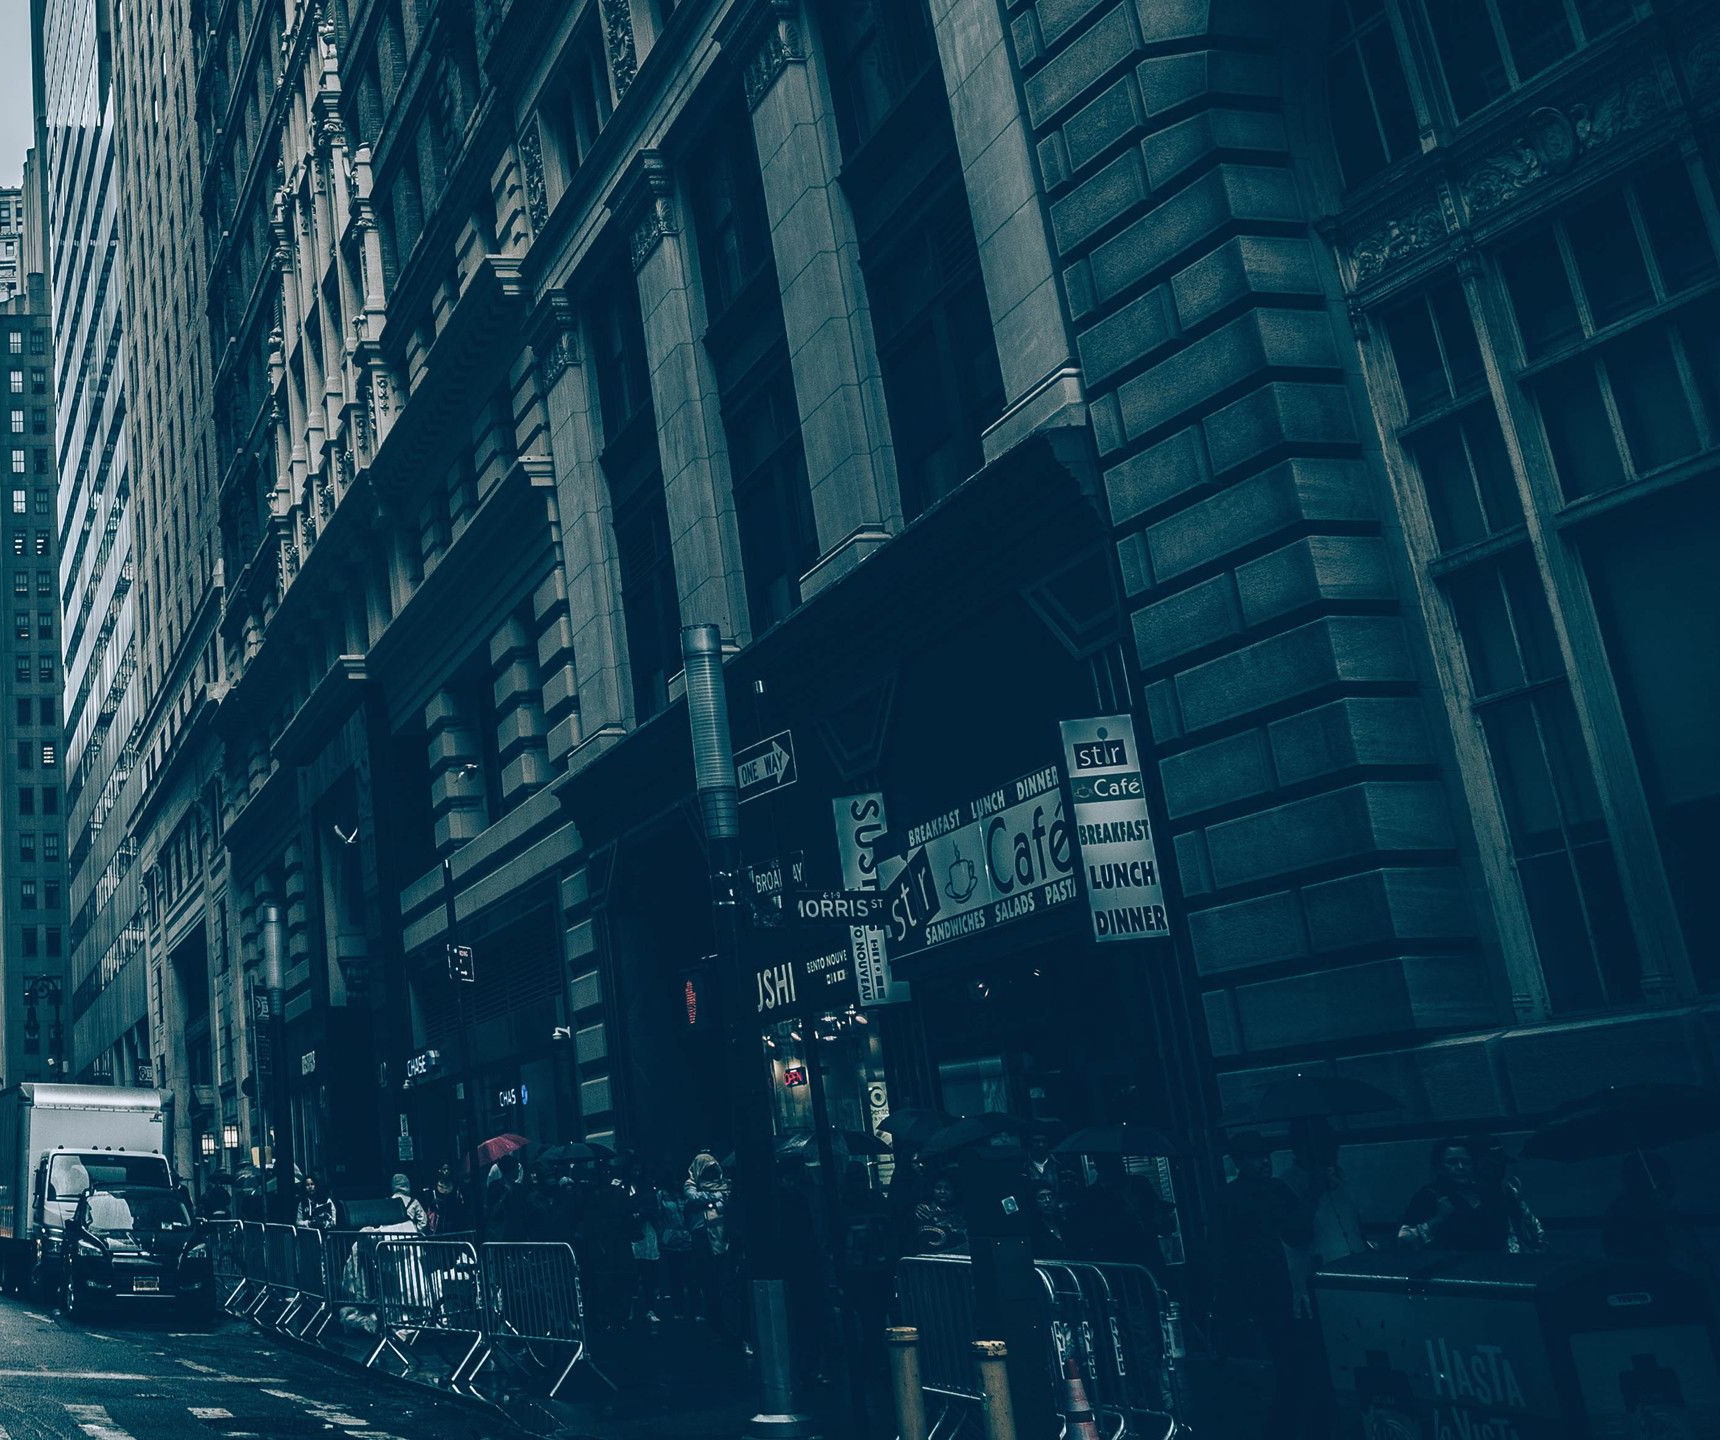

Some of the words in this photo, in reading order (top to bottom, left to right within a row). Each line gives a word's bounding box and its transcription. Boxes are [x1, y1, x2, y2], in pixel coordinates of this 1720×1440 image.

[741, 761, 758, 785] ONE
[762, 750, 783, 777] WAY
[1080, 739, 1120, 767] stir
[1094, 778, 1141, 797] Café
[908, 807, 960, 847] BREAKFAST
[970, 789, 1006, 819] LUNCH
[1016, 765, 1059, 801] DINNER
[1078, 819, 1149, 845] BREAKFAST
[986, 801, 1073, 894] Café
[1089, 860, 1156, 890] LUNCH
[871, 899, 884, 910] ST
[925, 909, 986, 946] SANDWICHES
[994, 891, 1035, 923] SALADS
[1094, 905, 1168, 936] DINNER
[806, 957, 825, 974] BENTO
[855, 942, 872, 1001] NOUVEAU
[407, 1055, 427, 1077] CHASE
[1425, 1337, 1526, 1408] HASTA
